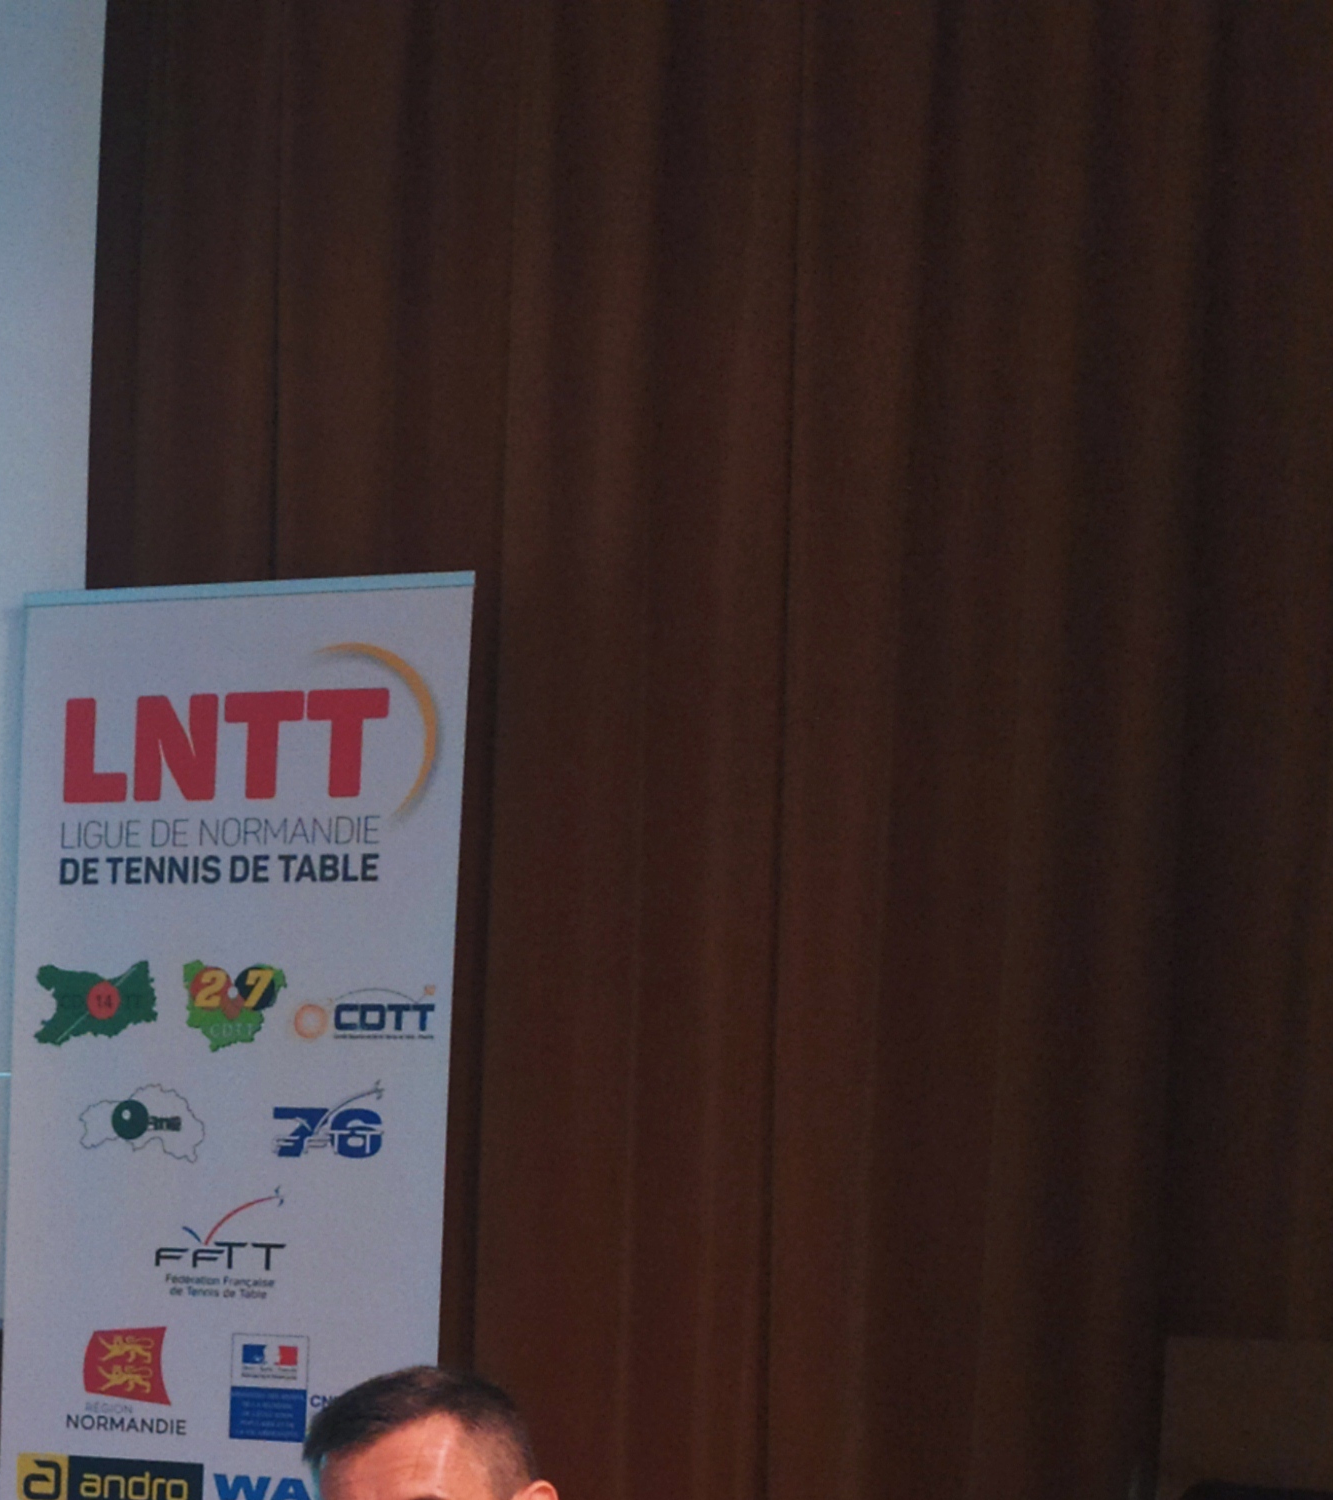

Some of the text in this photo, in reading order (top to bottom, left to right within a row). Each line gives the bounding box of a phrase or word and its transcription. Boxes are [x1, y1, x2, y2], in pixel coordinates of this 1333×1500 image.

[63, 688, 389, 804] LNTT
[61, 815, 380, 849] LIGUE DE NORMANDIE
[59, 853, 379, 886] DE TENNIS DE TABLE
[95, 993, 113, 1009] 14
[193, 968, 274, 1009] 27
[334, 1003, 436, 1031] CDTT
[273, 1106, 383, 1158] 76
[154, 1241, 287, 1271] FFTT
[169, 1286, 268, 1300] de Tennis de Table
[65, 1414, 187, 1436] NORMANDIE
